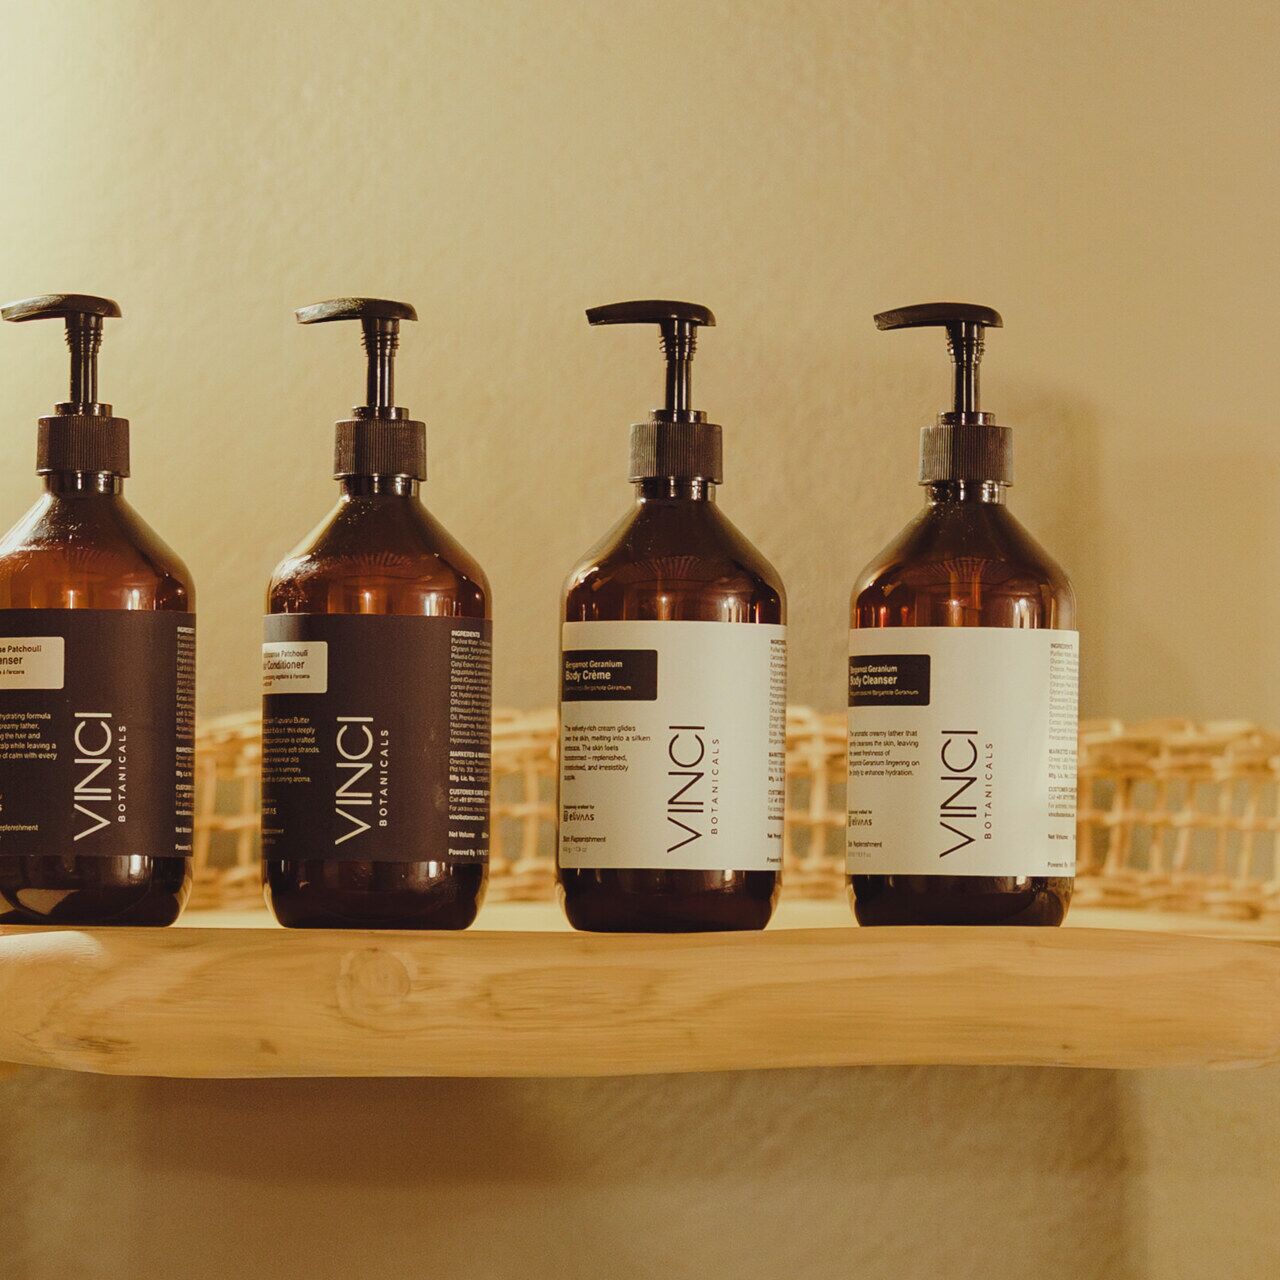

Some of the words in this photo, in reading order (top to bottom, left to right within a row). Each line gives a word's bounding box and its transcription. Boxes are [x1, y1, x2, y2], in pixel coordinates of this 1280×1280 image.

[7, 645, 42, 653] Patchouli
[267, 660, 305, 670] Conditioner
[589, 660, 623, 668] Geranium
[868, 665, 898, 673] Geranium
[565, 671, 581, 682] Body
[582, 669, 612, 680] Crème
[862, 674, 898, 685] Cleanser
[0, 713, 26, 721] hydrating
[617, 725, 636, 733] glides
[591, 735, 611, 743] melting
[897, 740, 919, 748] leaving
[27, 742, 50, 751] leaving
[38, 752, 58, 760] every
[73, 712, 112, 842] VINCI
[118, 724, 127, 823] BOTANICALS
[379, 729, 389, 827] BOTANICALS
[335, 717, 373, 845] VINCI
[711, 738, 719, 834] BOTANICALS
[667, 725, 705, 853] VINCI
[939, 730, 978, 858] VINCI
[984, 743, 993, 839] BOTANICALS
[448, 848, 470, 856] Powered
